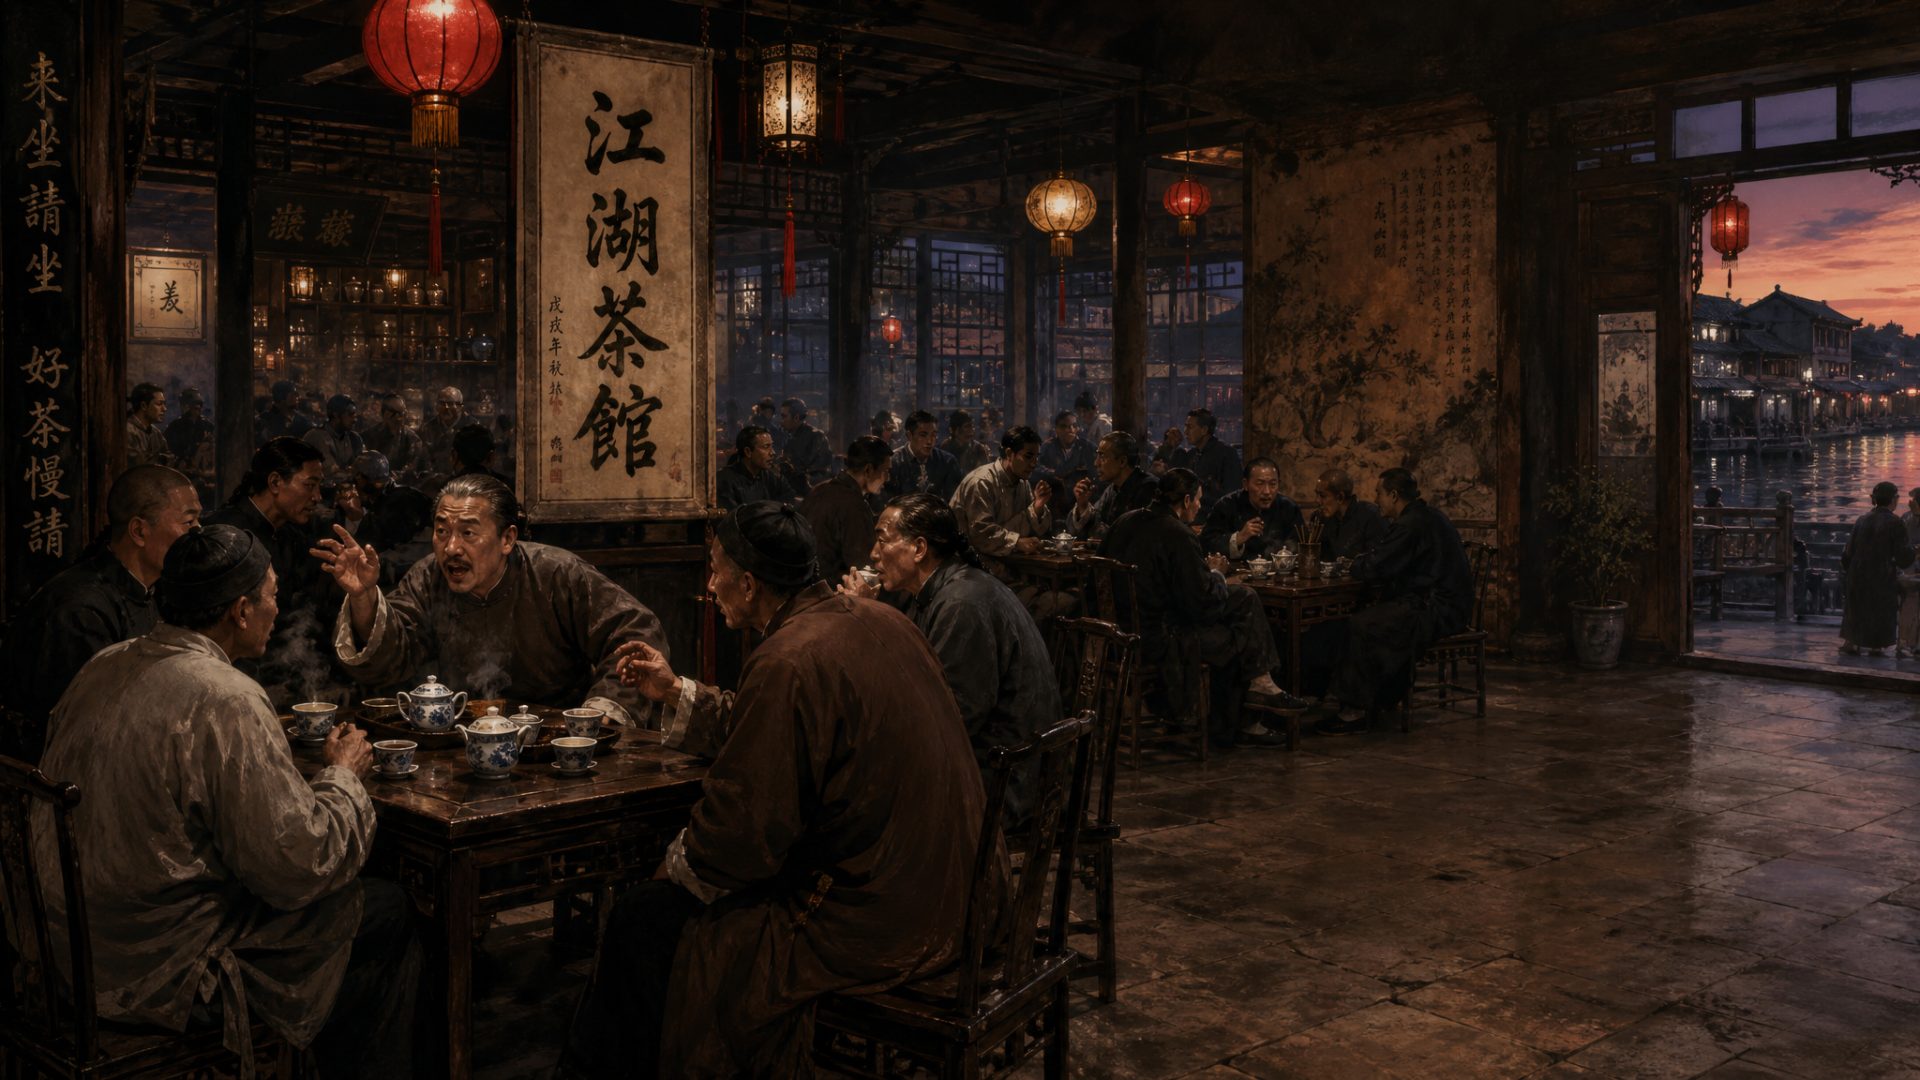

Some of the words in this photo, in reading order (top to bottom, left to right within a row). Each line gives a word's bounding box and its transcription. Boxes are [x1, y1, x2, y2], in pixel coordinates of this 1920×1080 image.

[574, 91, 669, 477] 江湖茶館
[21, 346, 70, 557] 好茶慢請
